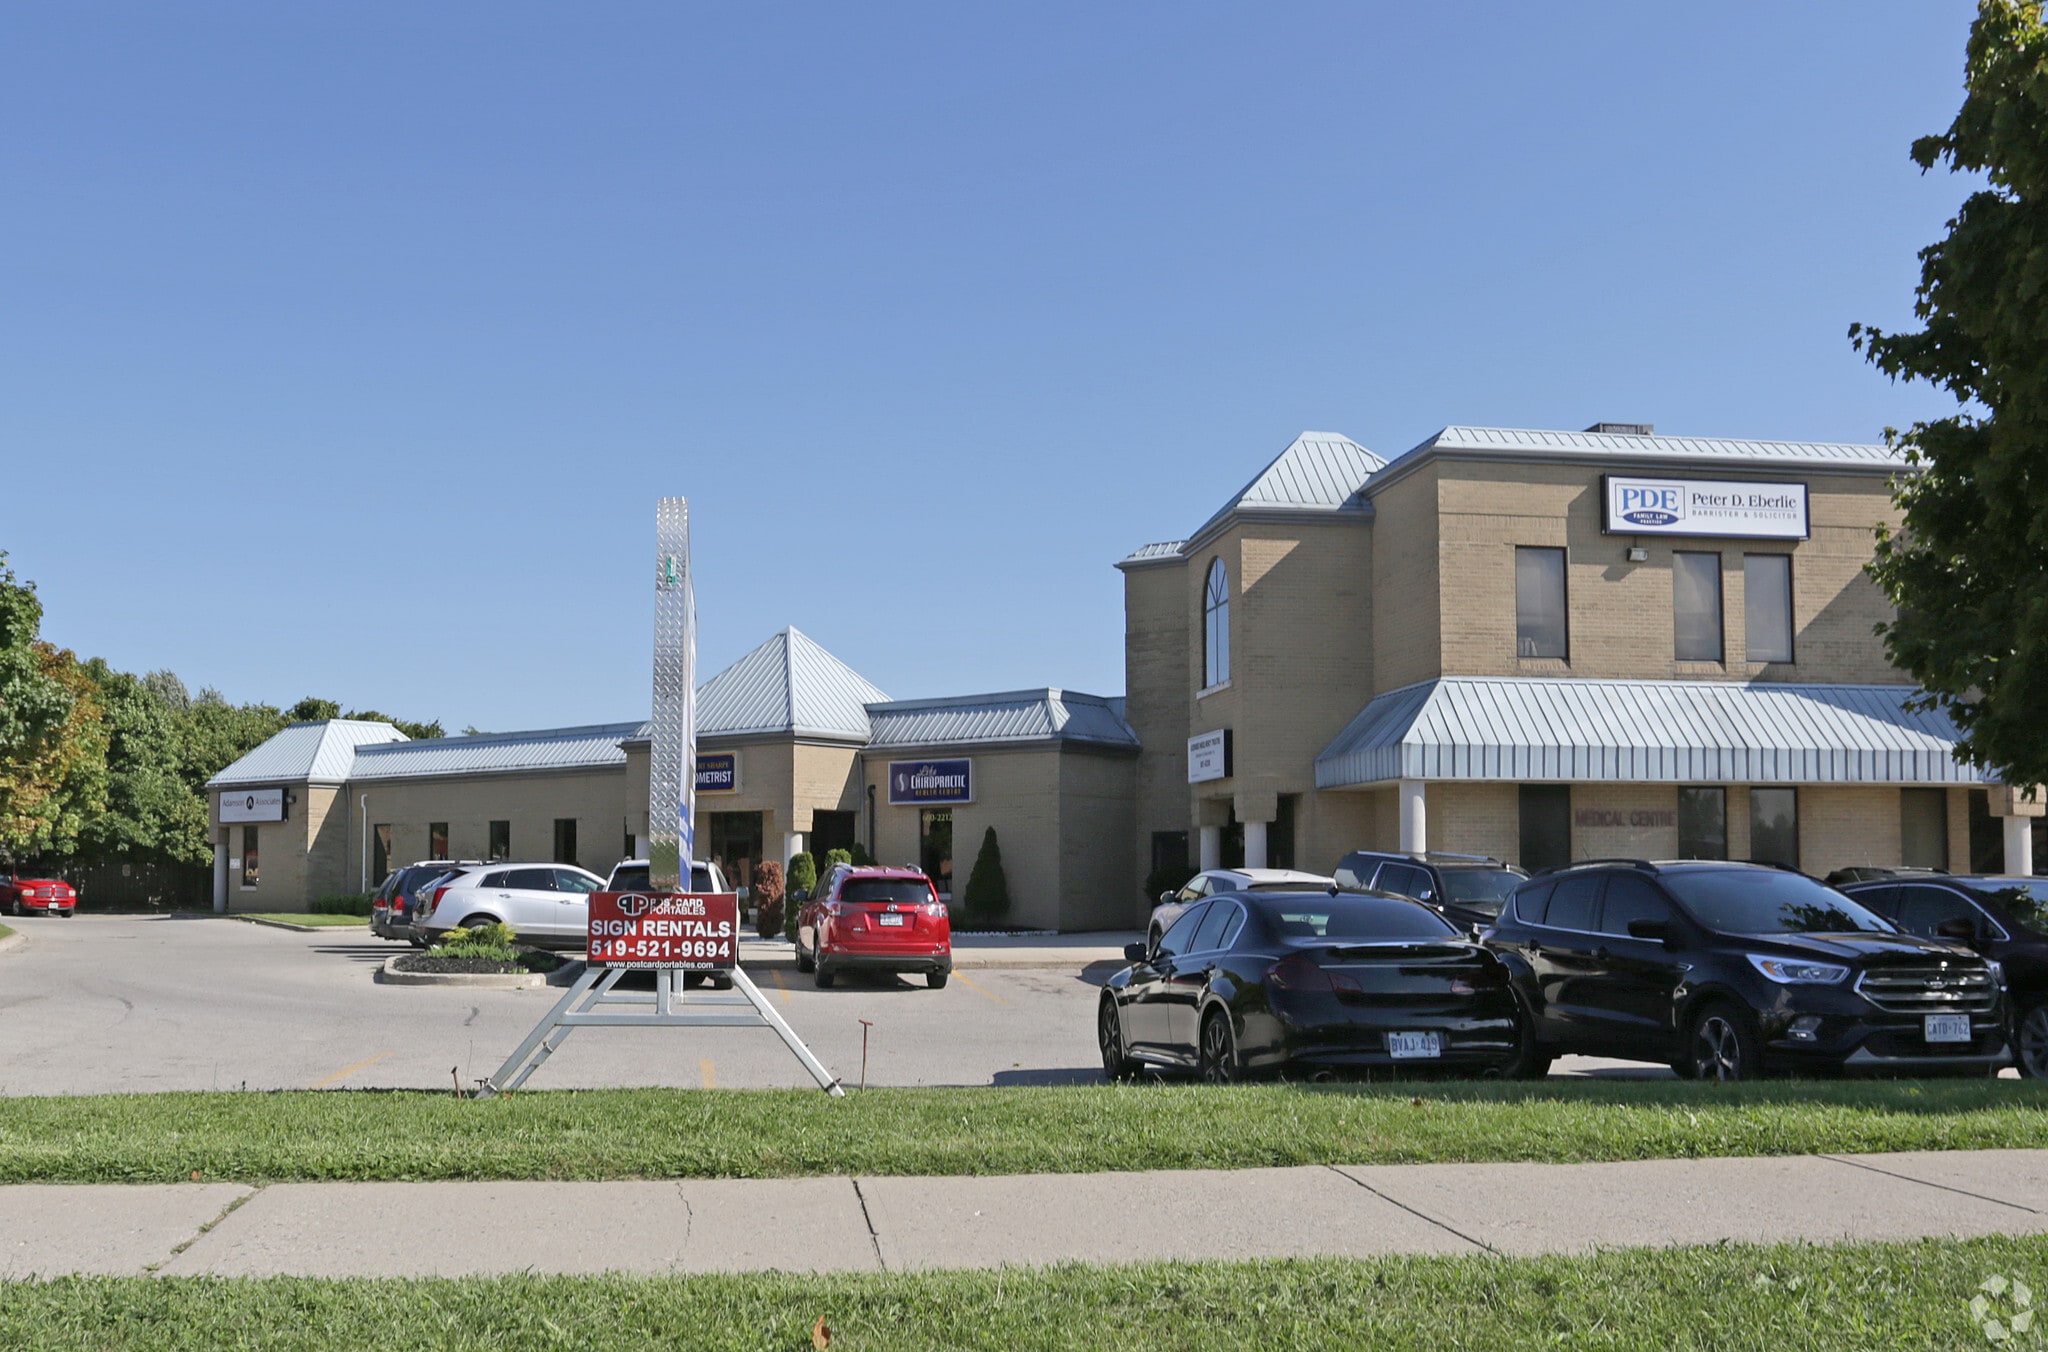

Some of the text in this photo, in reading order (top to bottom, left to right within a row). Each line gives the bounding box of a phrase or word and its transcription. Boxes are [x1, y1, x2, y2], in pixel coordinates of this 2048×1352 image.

[1621, 487, 1679, 512] PDE
[1692, 493, 1797, 508] Peter D. Eberlie
[1692, 509, 1739, 518] BARRISTER
[1753, 511, 1797, 519] SOLICITOR
[695, 770, 732, 784] OMETRIST
[910, 774, 966, 789] CHIROPRACTIC
[1575, 808, 1674, 826] MEDICAL CENTRE
[676, 898, 703, 907] CARD
[650, 906, 706, 916] PORTABLES
[590, 919, 731, 937] SIGN RENTALS
[591, 940, 730, 958] 519-521-9694
[606, 960, 714, 969] www.postcardportables.com
